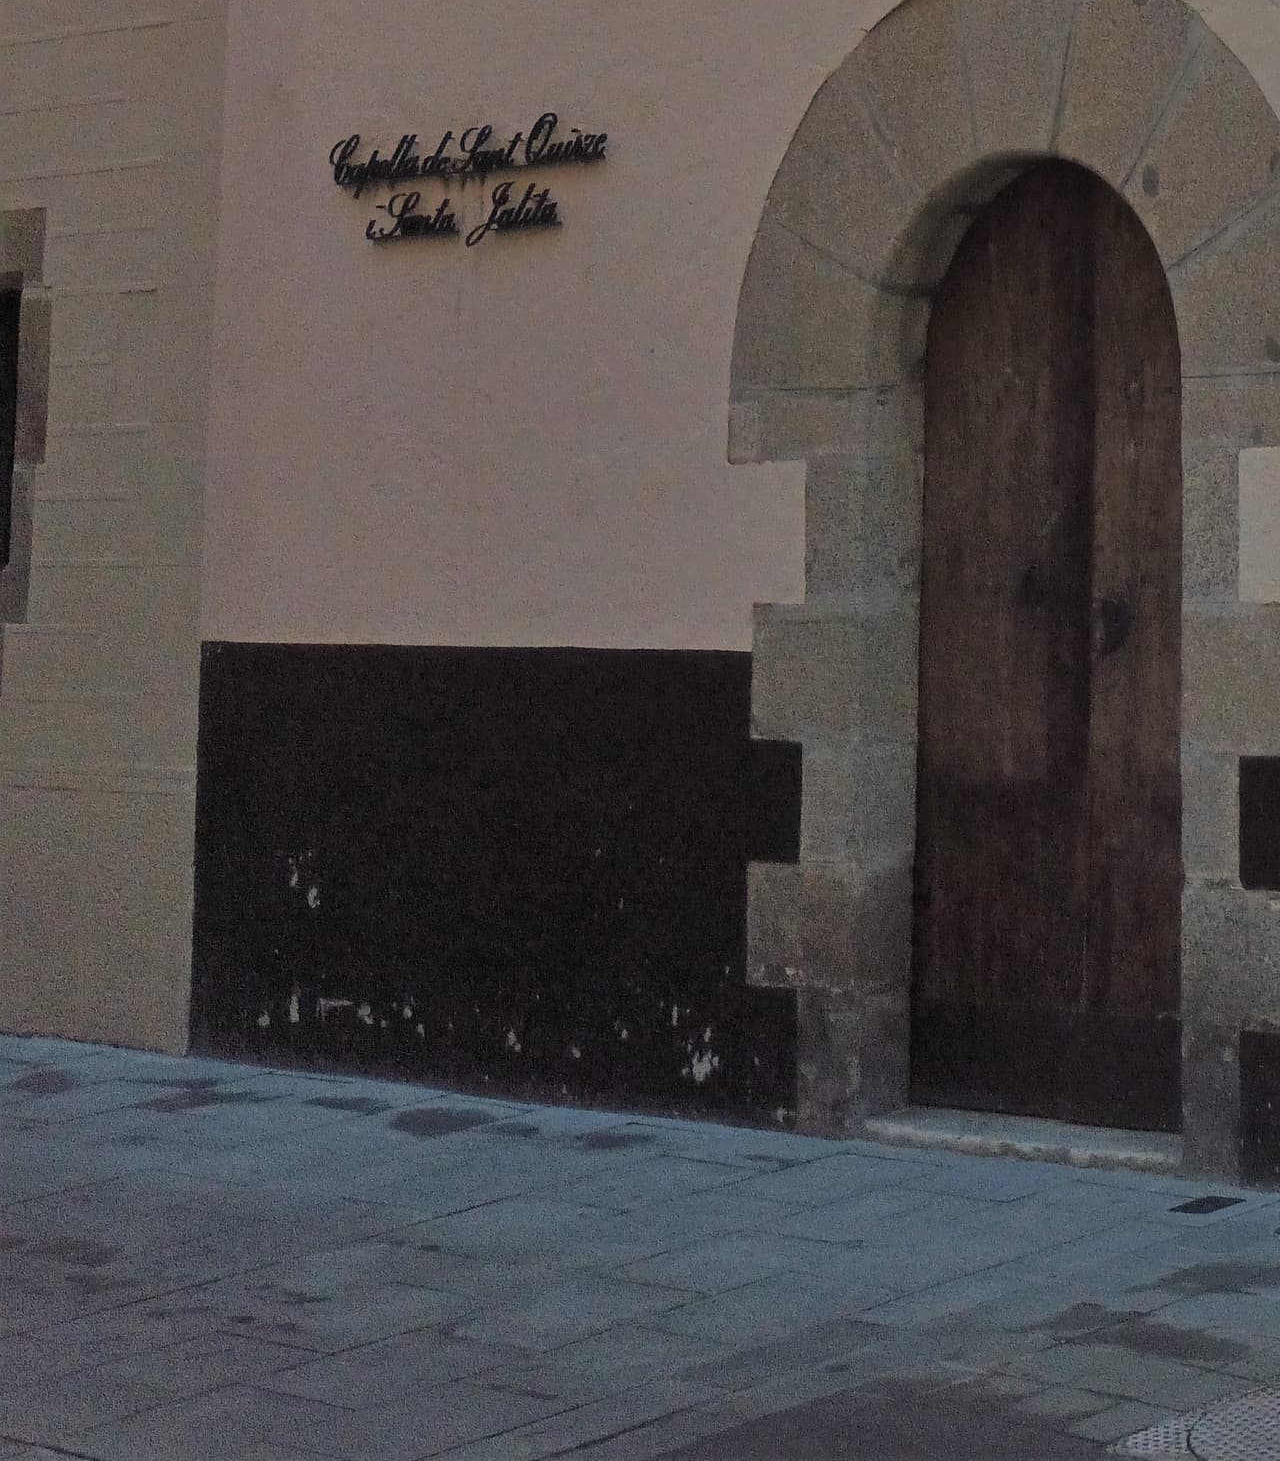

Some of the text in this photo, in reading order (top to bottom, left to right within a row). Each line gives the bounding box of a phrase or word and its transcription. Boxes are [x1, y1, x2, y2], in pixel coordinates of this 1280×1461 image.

[329, 134, 420, 199] Capella
[457, 125, 525, 173] Sant
[385, 191, 459, 236] Santa
[466, 181, 562, 247] Julita
